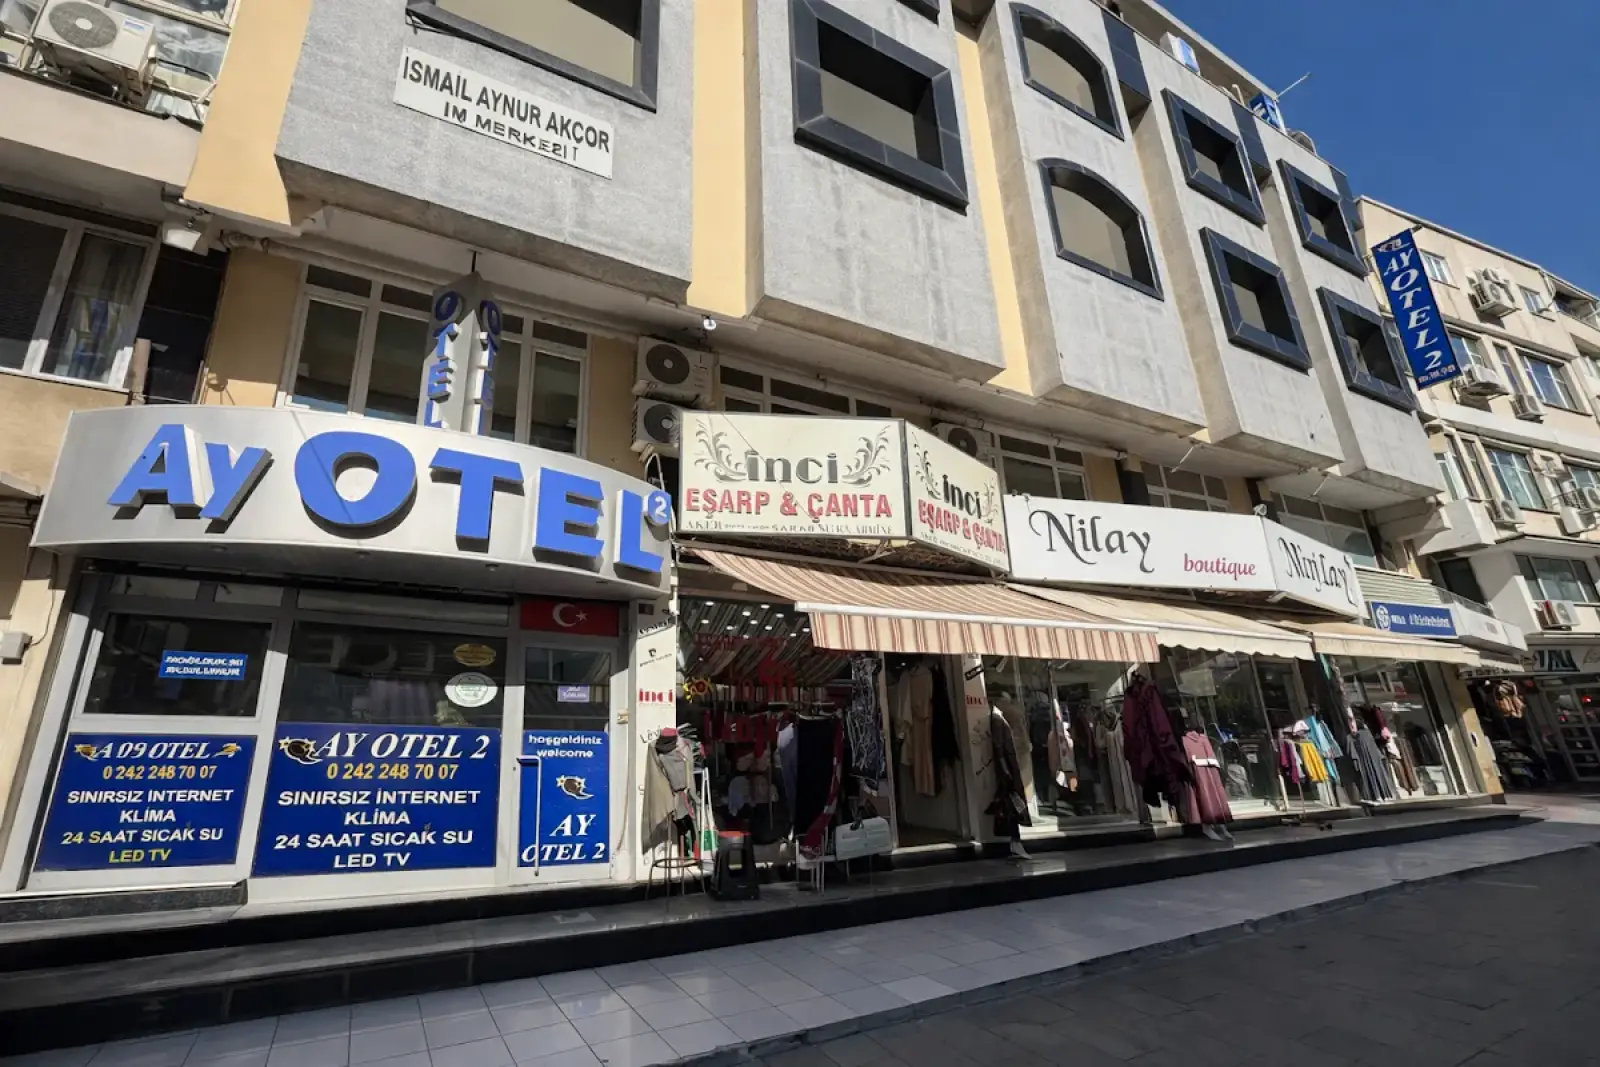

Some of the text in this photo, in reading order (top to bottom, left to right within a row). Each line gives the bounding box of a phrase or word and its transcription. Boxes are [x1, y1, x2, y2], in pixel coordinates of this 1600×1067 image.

[476, 86, 541, 128] AYNUR
[1390, 268, 1439, 349] OTEL
[1424, 350, 1443, 372] 2
[294, 430, 664, 576] OTEL
[942, 474, 982, 519] inci
[779, 490, 798, 516] &
[807, 492, 893, 524] ÇANTA
[962, 518, 972, 540] &
[1028, 509, 1155, 574] Nilay
[1183, 552, 1257, 582] boutique
[148, 742, 211, 760] OTEL
[370, 733, 464, 760] OTEL
[470, 735, 491, 760] 2
[536, 748, 594, 758] welcome
[103, 765, 218, 780] 0 242 248 70 07
[327, 763, 459, 780] 0 242 248 70 07
[67, 790, 143, 804] SINIRSIZ
[278, 790, 371, 806] SINIRSIZ
[344, 808, 410, 826] KLİMA
[549, 814, 596, 837] AY
[60, 832, 84, 845] 24
[88, 830, 137, 844] SAAT
[199, 828, 223, 841] SU
[274, 834, 300, 850] 24
[306, 832, 365, 848] SAAT
[442, 830, 473, 845] SU
[108, 848, 172, 864] LED TV
[333, 852, 411, 869] LED TV
[592, 842, 605, 860] 2
